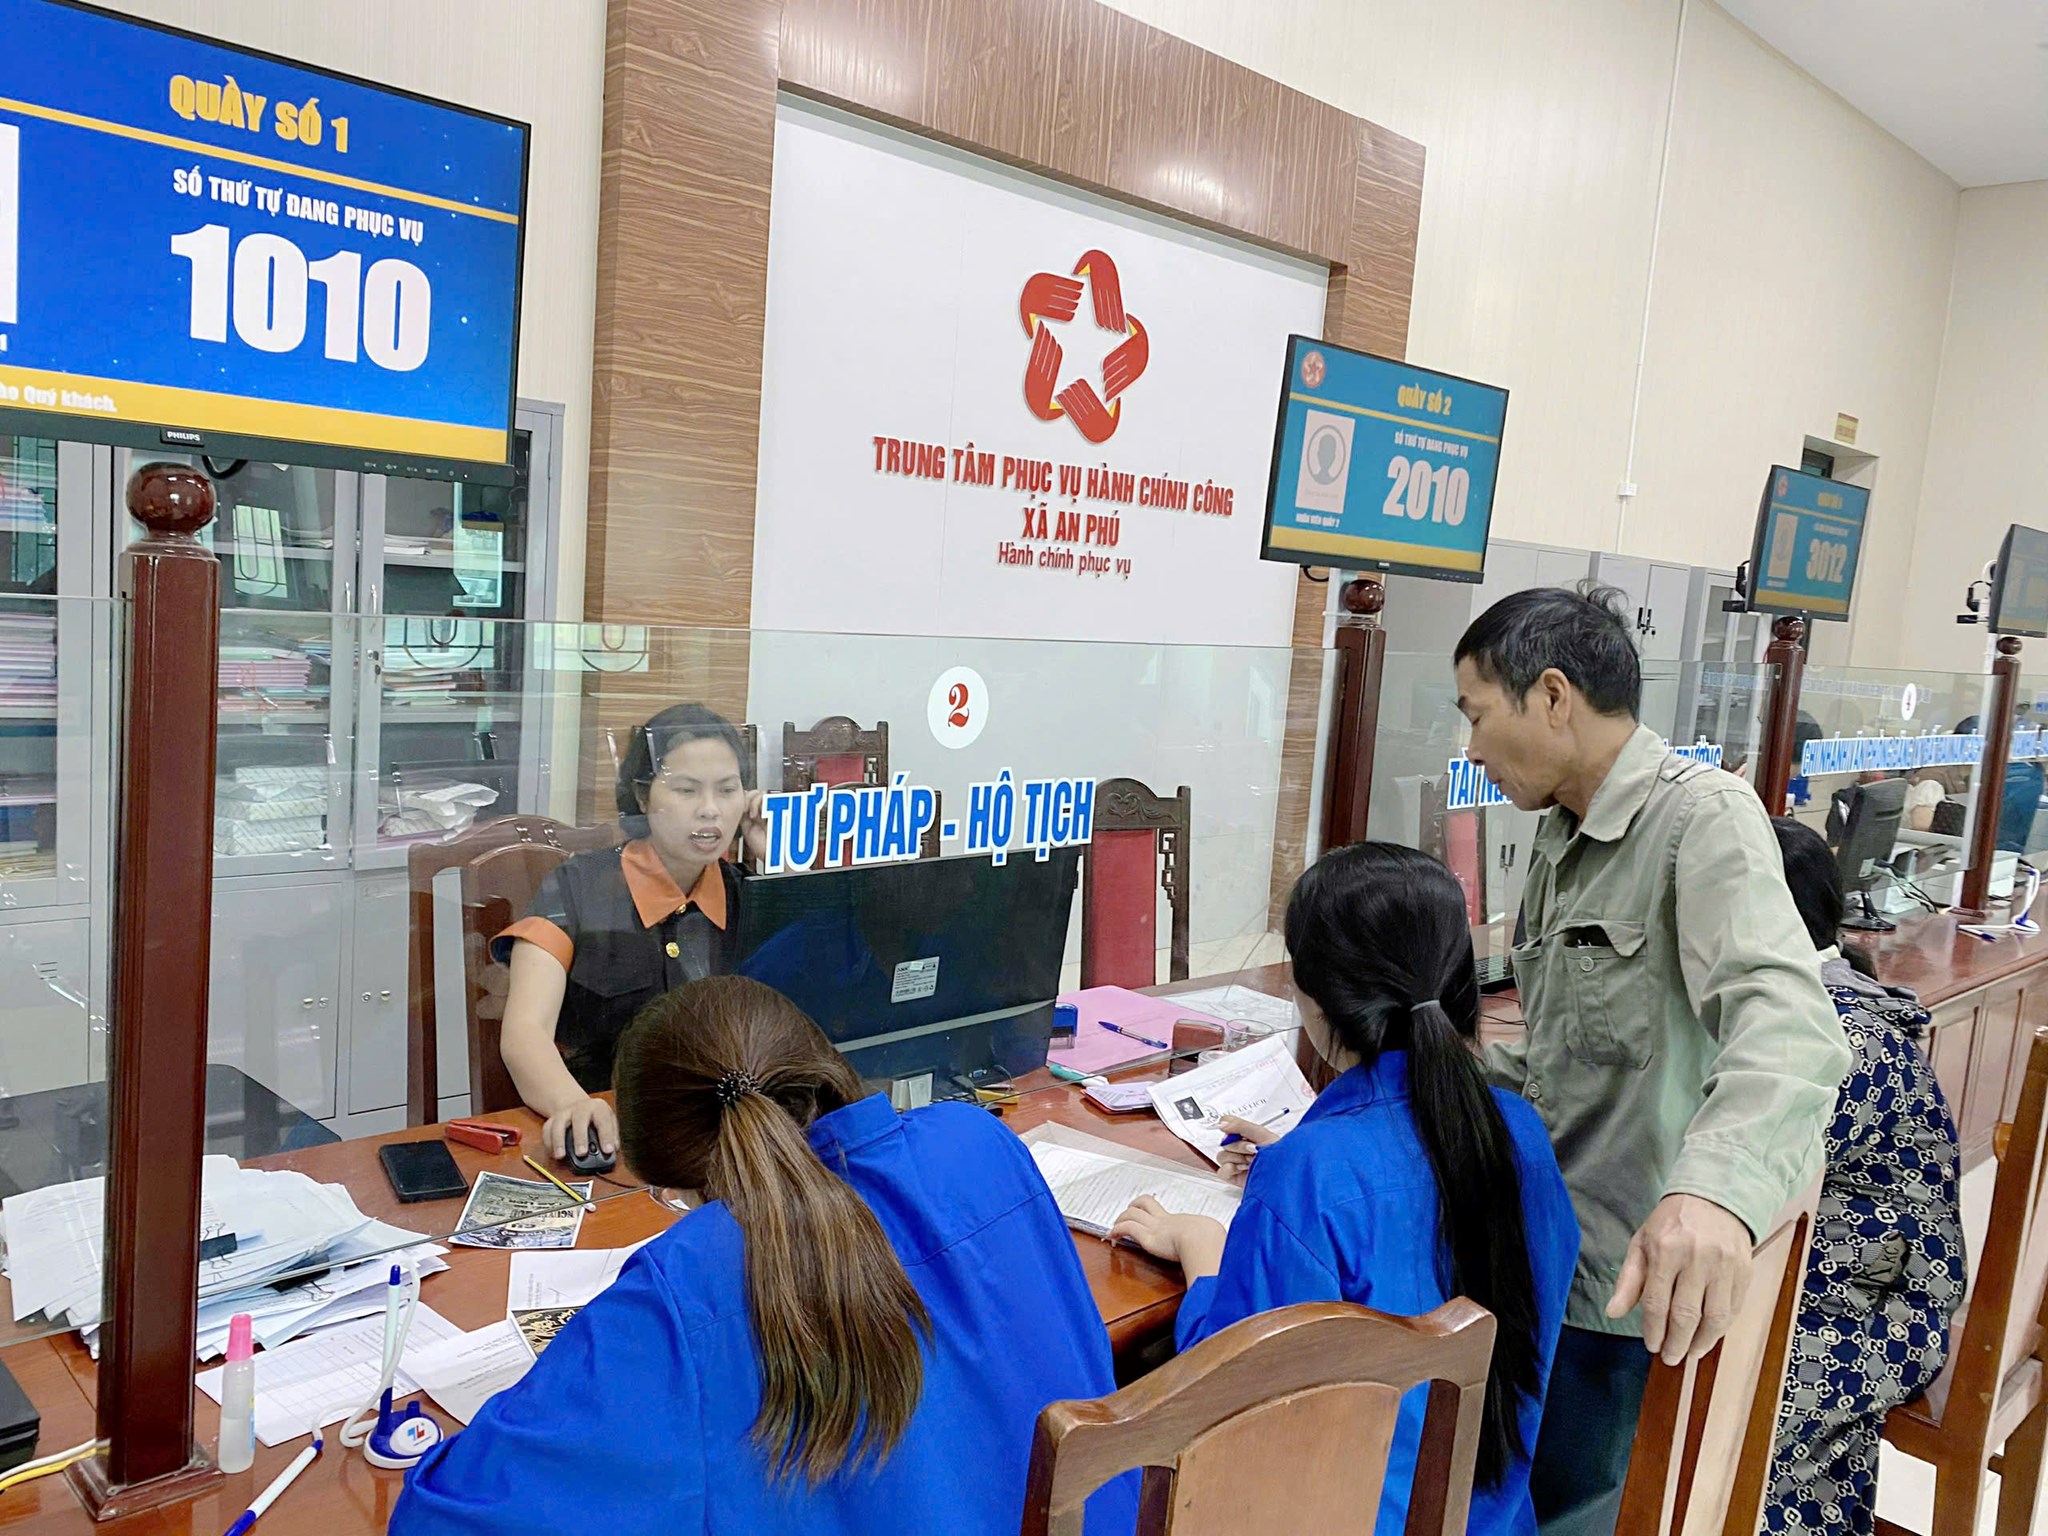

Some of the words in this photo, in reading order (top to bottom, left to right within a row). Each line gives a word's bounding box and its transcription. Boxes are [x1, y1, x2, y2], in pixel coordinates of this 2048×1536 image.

[275, 97, 322, 146] SỐ
[331, 116, 348, 153] 1
[173, 165, 202, 196] SỐ
[208, 176, 252, 208] THỨ
[255, 188, 283, 217] TỰ
[286, 193, 339, 226] ĐANG
[344, 206, 395, 238] PHỤC
[399, 217, 424, 246] VỤ
[171, 223, 431, 372] 1010
[23, 385, 57, 406] Quý
[1442, 396, 1452, 416] 2
[167, 430, 200, 442] PHILIPS
[873, 436, 946, 481] TRUNG
[952, 441, 995, 486] TÂM
[1001, 456, 1053, 501] PHỤC
[1059, 464, 1082, 503] VỤ
[1087, 462, 1135, 503] HÀNH
[1139, 472, 1189, 511] CHÍNH
[1193, 478, 1234, 516] CÔNG
[1382, 455, 1470, 526] 2010
[1022, 502, 1048, 539] XÃ
[1055, 511, 1081, 542] AN
[1085, 510, 1120, 547] PHÚ
[999, 541, 1033, 567] Hành
[1039, 546, 1074, 570] chính
[1078, 550, 1111, 578] phục
[1116, 558, 1132, 580] vụ
[1806, 538, 1848, 583] 3012
[948, 683, 969, 727] 2
[764, 784, 827, 869] TƯ
[826, 772, 936, 864] PHÁP
[966, 769, 1014, 864] HỘ
[1024, 780, 1095, 858] TỊCH
